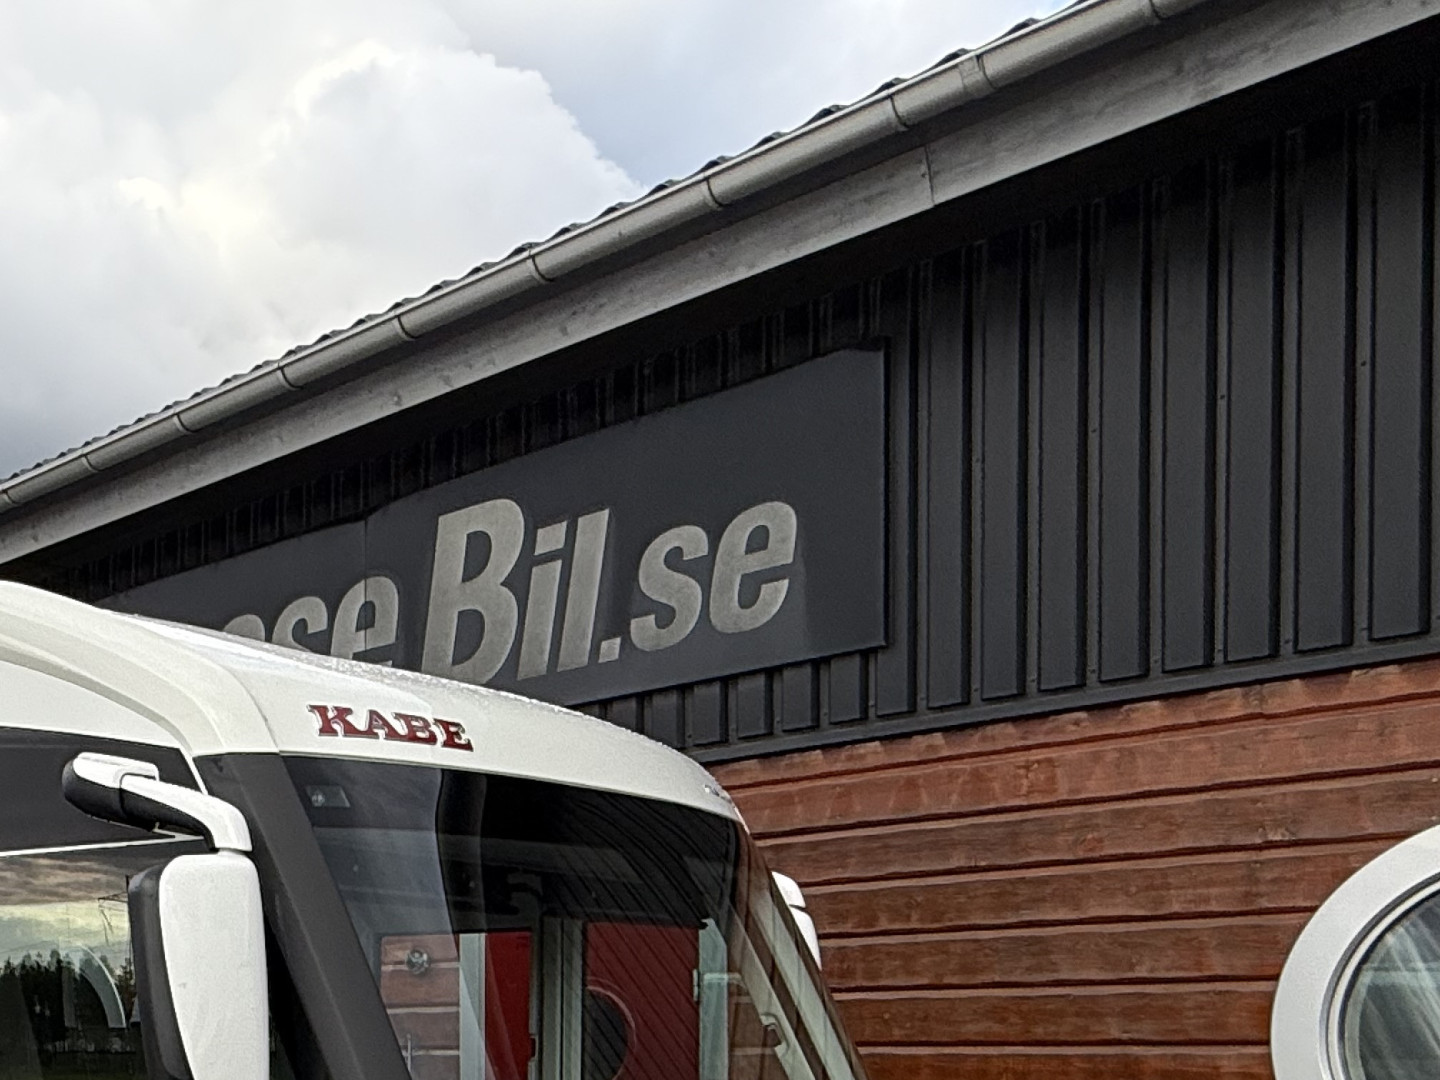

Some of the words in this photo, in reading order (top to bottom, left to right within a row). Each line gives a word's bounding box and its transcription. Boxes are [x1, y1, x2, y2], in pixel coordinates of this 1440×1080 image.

[223, 574, 400, 667] se
[422, 498, 798, 684] Bil.se
[306, 703, 475, 752] KABE
